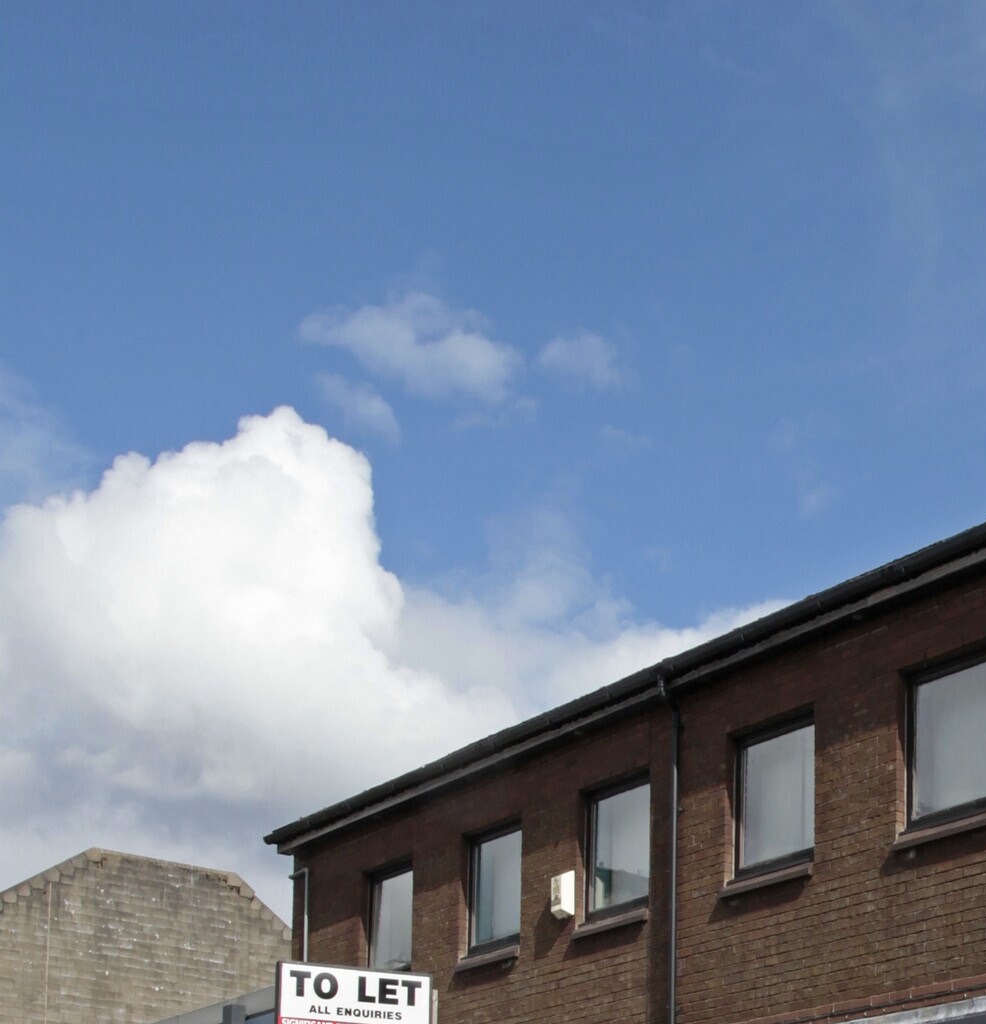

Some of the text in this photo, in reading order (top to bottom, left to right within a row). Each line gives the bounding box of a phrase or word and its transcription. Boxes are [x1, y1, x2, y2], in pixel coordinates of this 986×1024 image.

[289, 970, 422, 1006] TO LET
[309, 1005, 402, 1021] ALL ENQUIRIES
